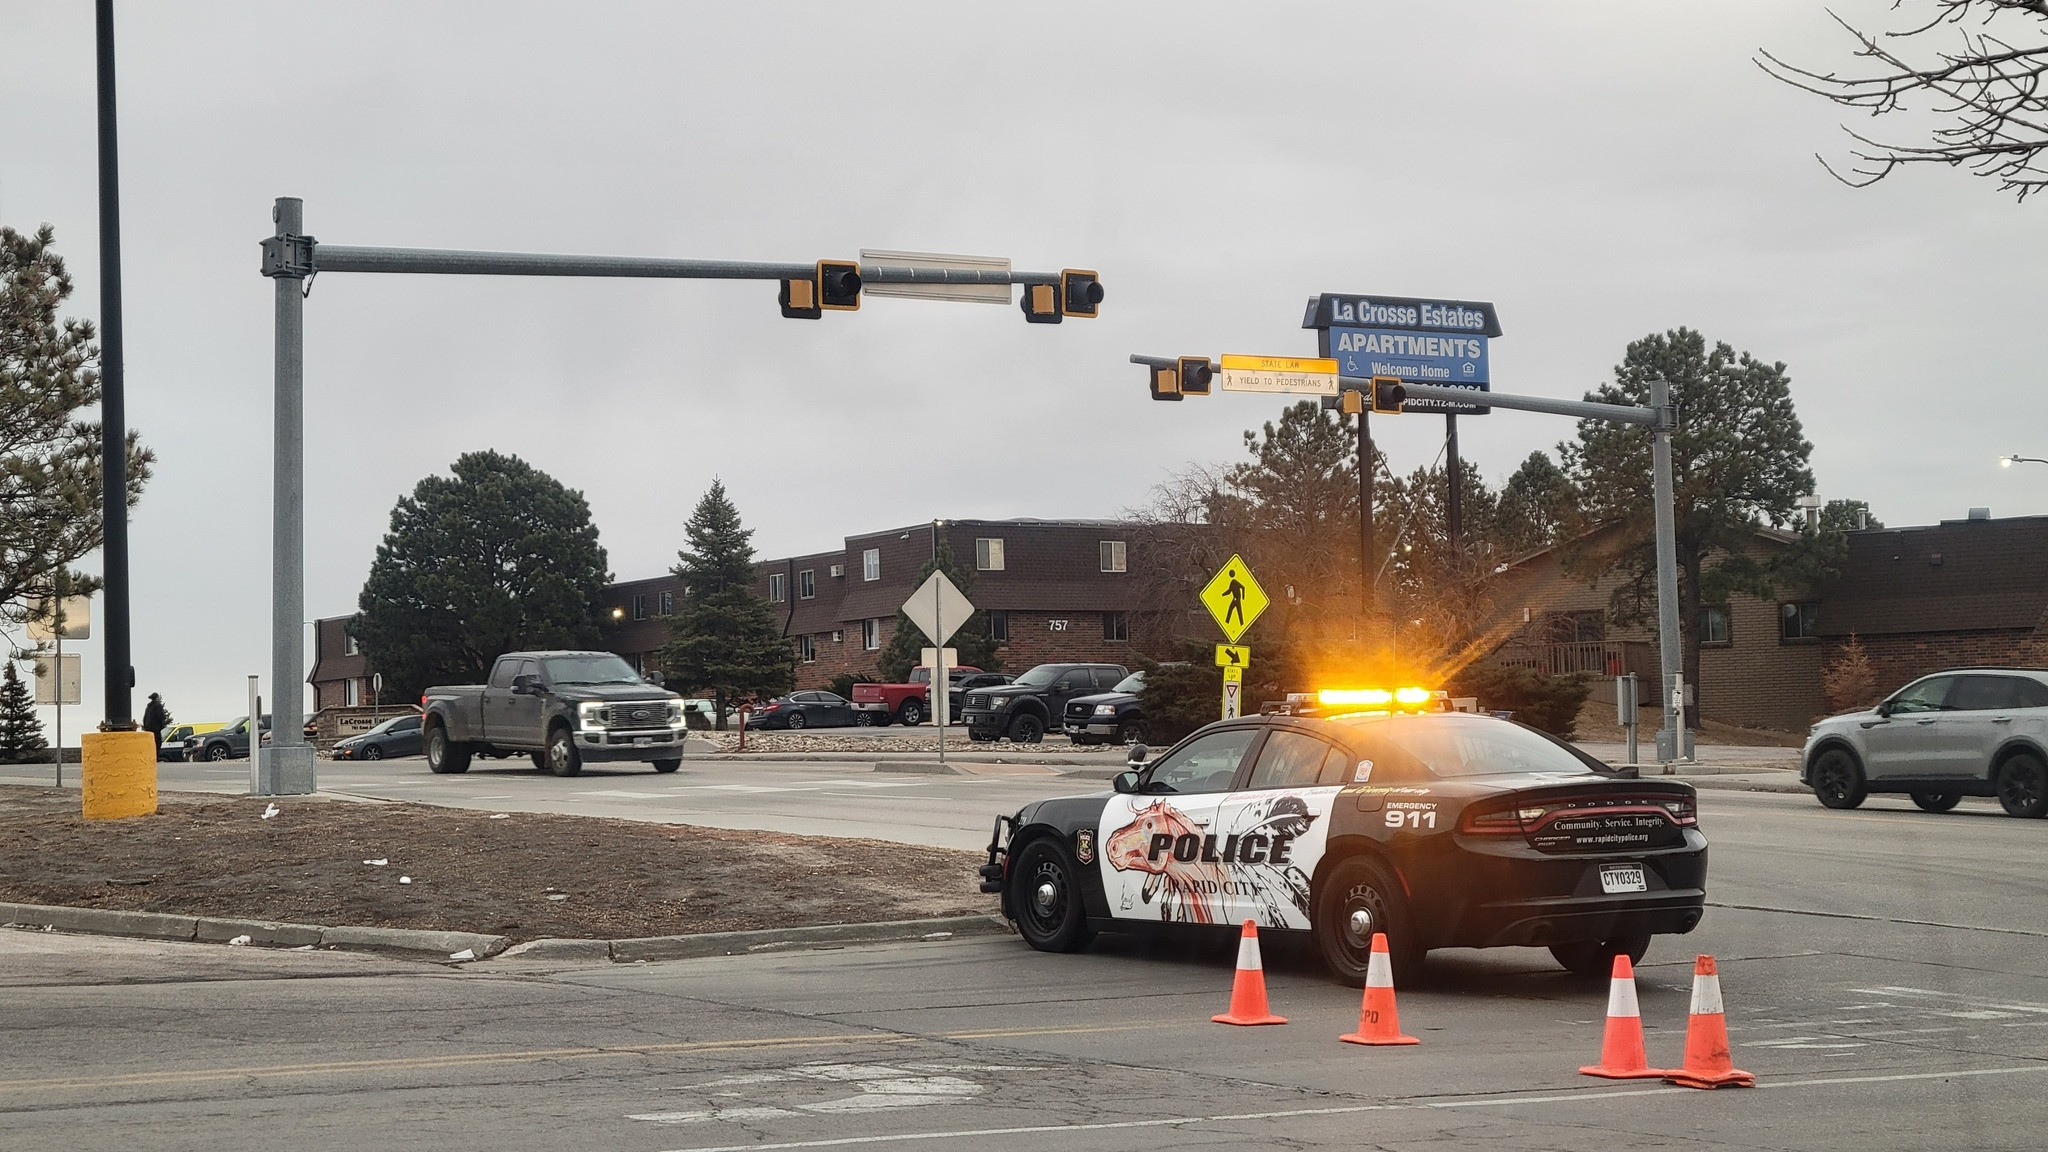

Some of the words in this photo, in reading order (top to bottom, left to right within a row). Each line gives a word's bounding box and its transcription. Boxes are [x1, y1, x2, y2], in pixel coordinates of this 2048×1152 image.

[1332, 299, 1354, 321] La
[1358, 301, 1417, 324] Crosse
[1422, 304, 1484, 328] Estates
[1338, 332, 1481, 359] APARTMENTS
[1261, 360, 1281, 368] STATE
[1286, 361, 1299, 369] LAW
[1371, 361, 1418, 376] Welcome
[1420, 364, 1450, 378] Home
[1239, 376, 1260, 385] YIELD
[1264, 378, 1272, 386] TO
[1276, 378, 1322, 388] PEDESTRIANS
[1049, 620, 1068, 631] 757
[1386, 802, 1438, 810] EMERGENCY
[1384, 811, 1437, 829] 911
[1554, 820, 1602, 831] Community.
[1605, 818, 1633, 828] Service.
[1635, 816, 1665, 828] Integrity.
[1576, 833, 1649, 844] www.rapidcitypolice.org
[1147, 833, 1295, 864] POLICE
[1603, 870, 1642, 886] CTY0329
[1172, 879, 1218, 896] RAPID
[1223, 880, 1262, 896] CITY
